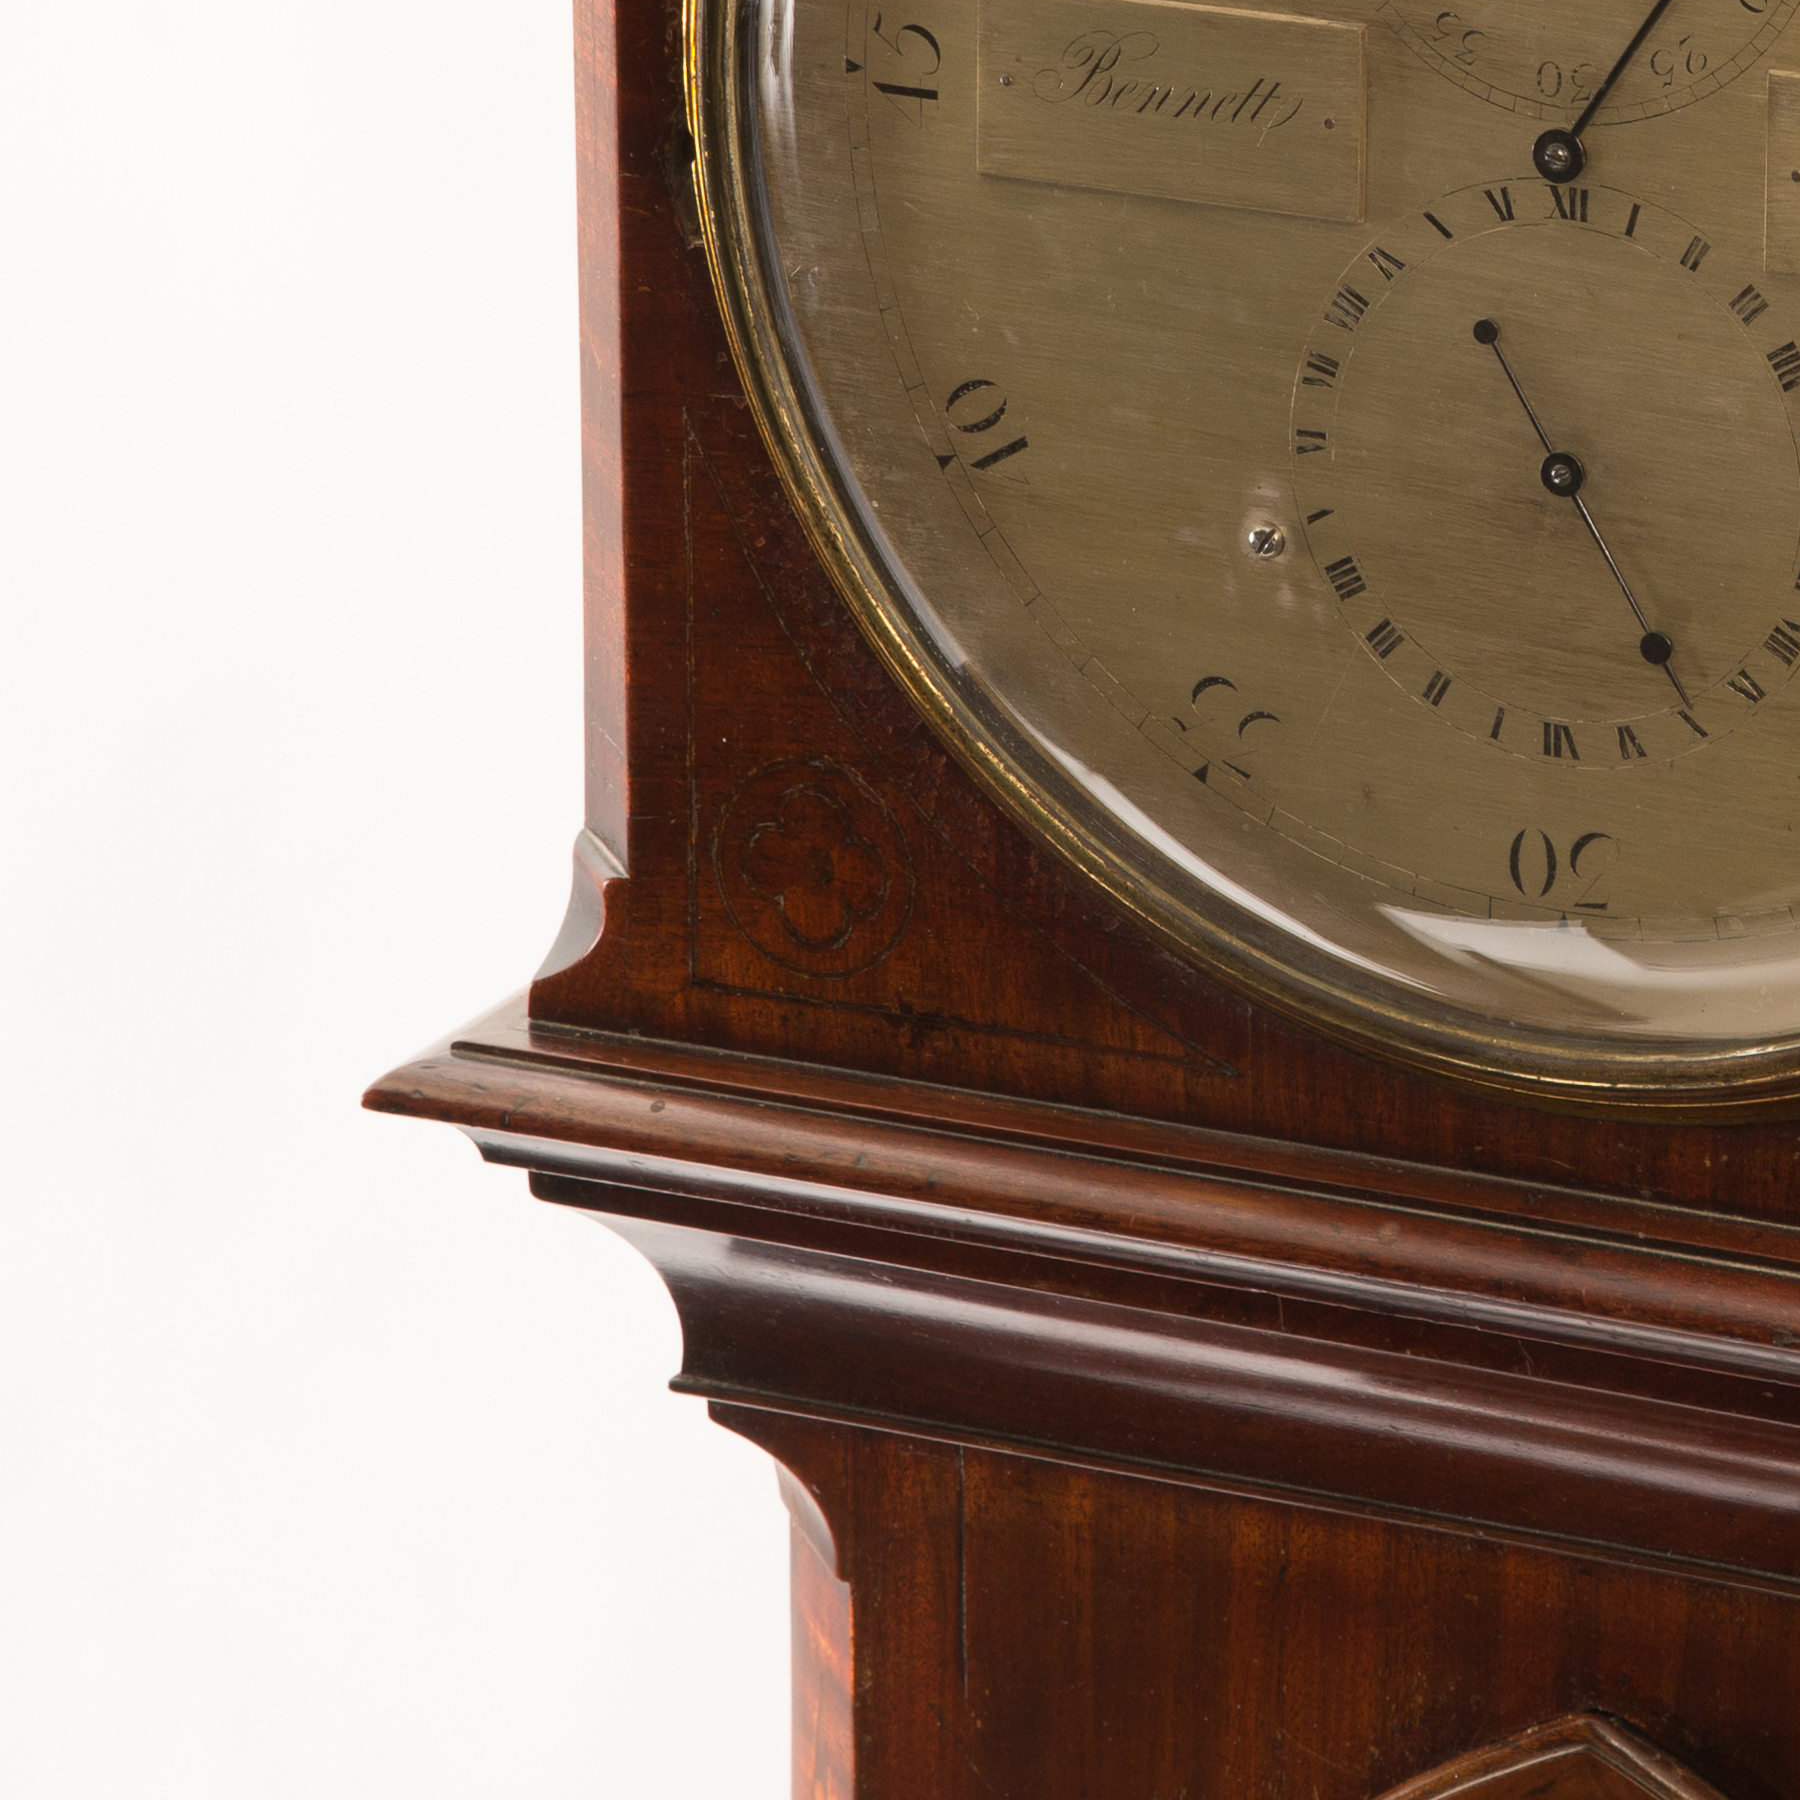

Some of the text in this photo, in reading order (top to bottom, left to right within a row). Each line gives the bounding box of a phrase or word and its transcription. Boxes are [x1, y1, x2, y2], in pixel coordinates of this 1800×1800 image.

[1430, 11, 1488, 67] 35
[1652, 34, 1709, 86] 25
[869, 11, 941, 130] 45
[1033, 30, 1303, 131] Bennett
[1535, 61, 1598, 104] 30
[1544, 184, 1588, 223] XII
[1625, 204, 1641, 236] I
[1679, 238, 1711, 272] II
[1729, 284, 1769, 323] III
[1324, 556, 1367, 600] IIII
[1365, 618, 1405, 659] III
[1421, 670, 1451, 706] II
[1171, 676, 1286, 779] 35
[1509, 828, 1621, 909] 30
